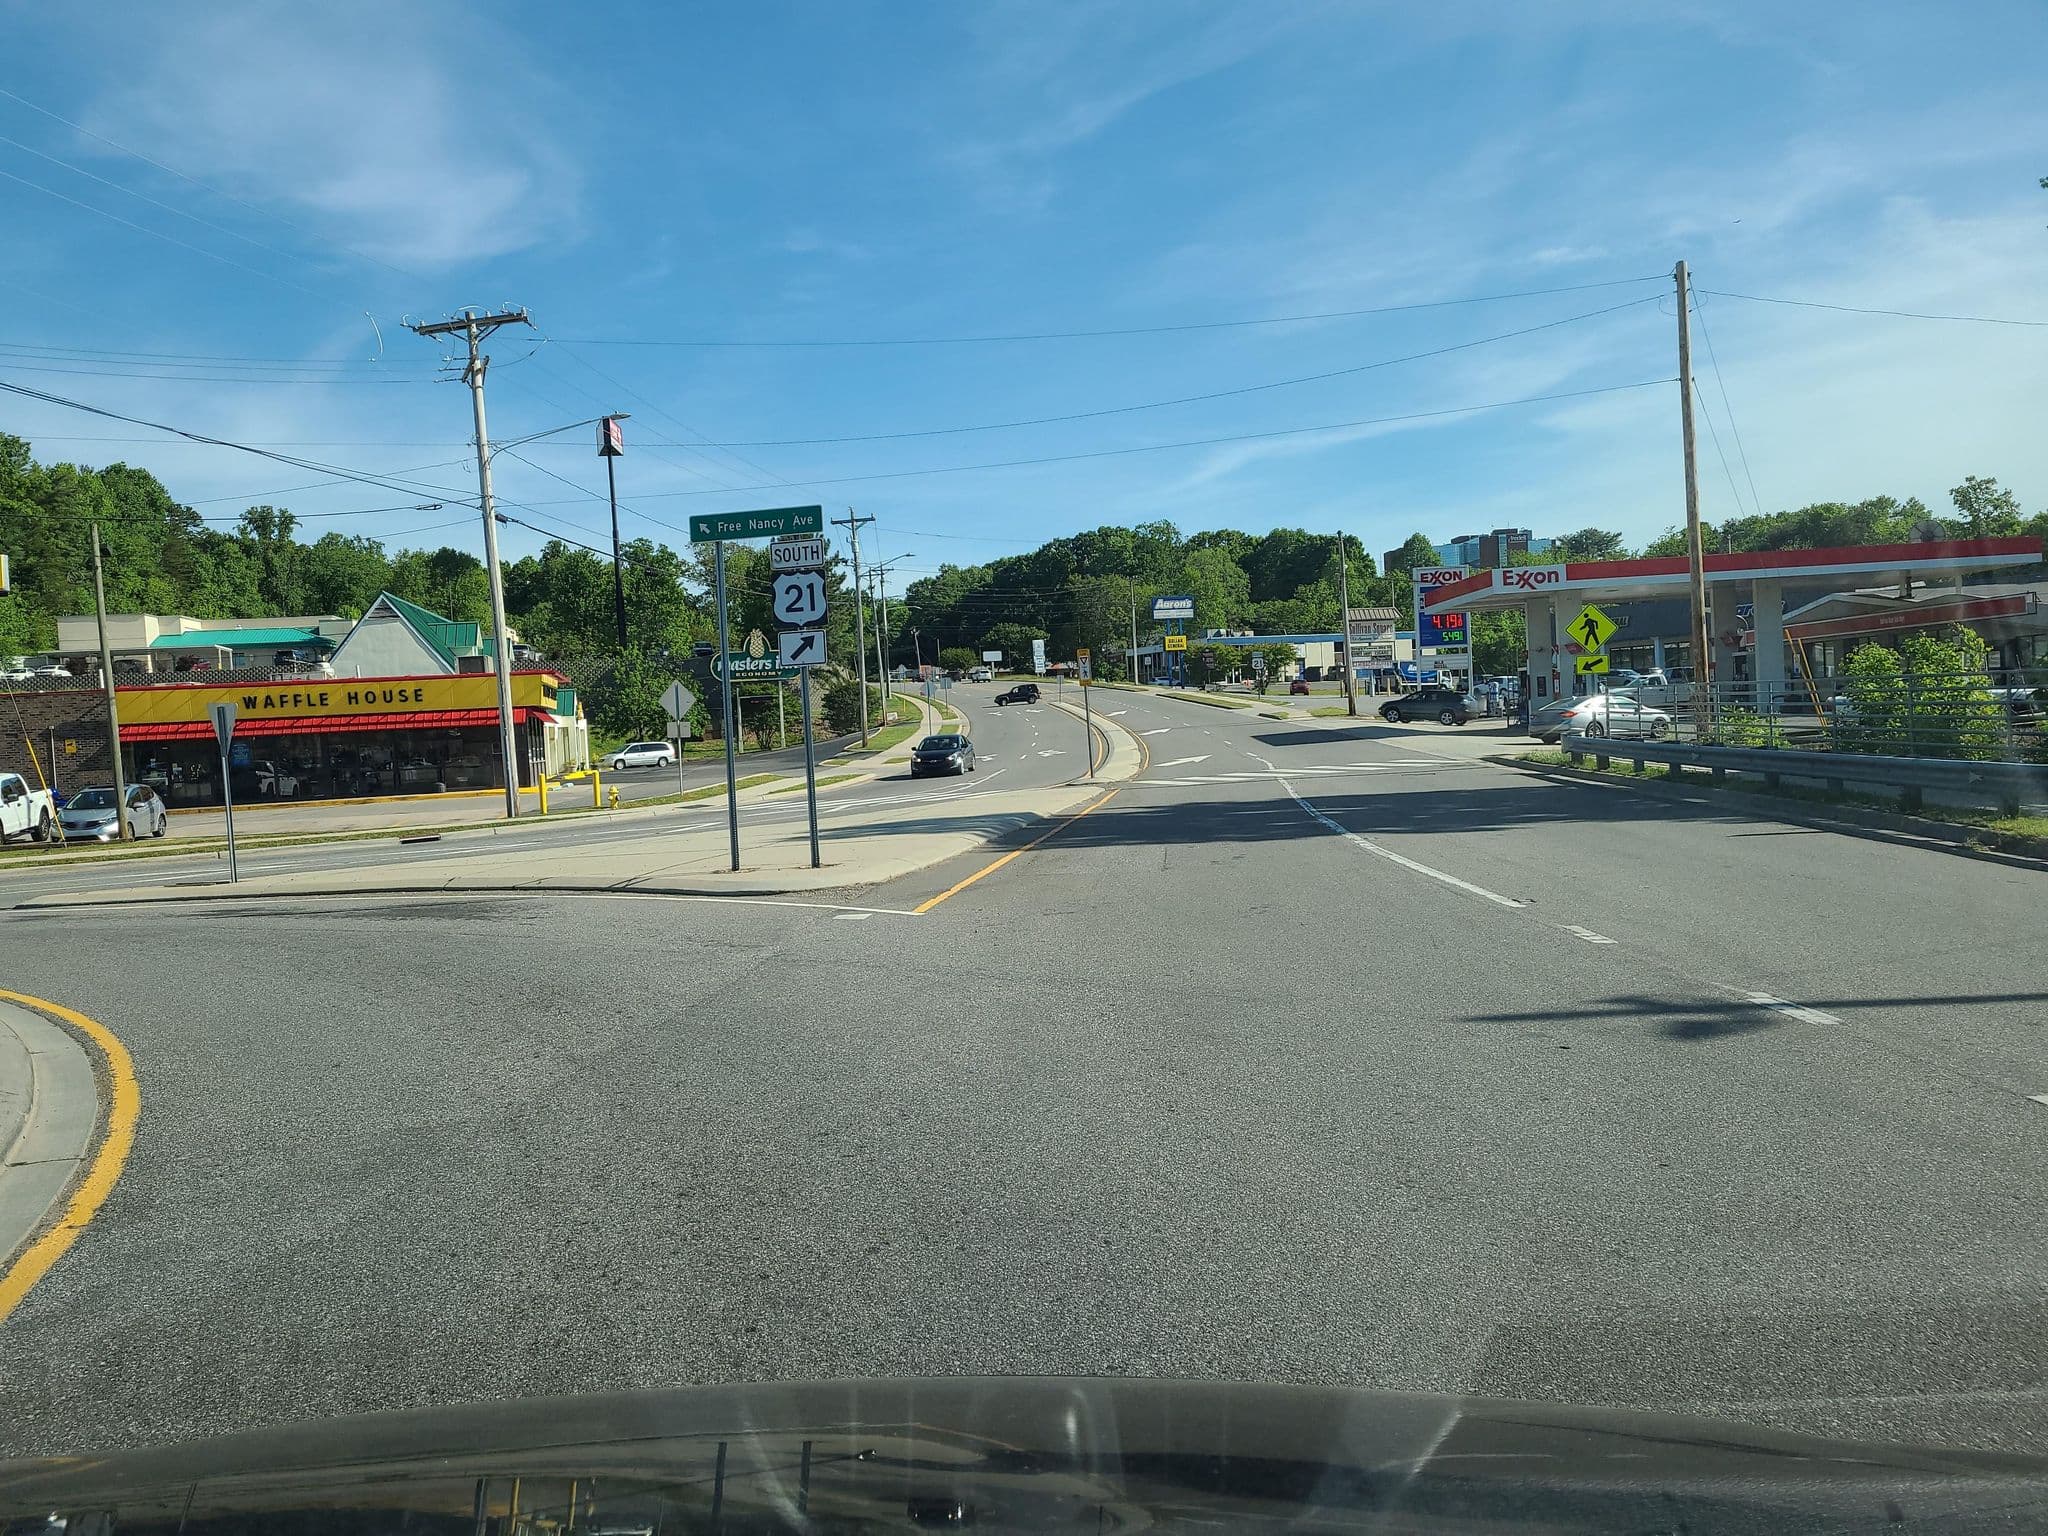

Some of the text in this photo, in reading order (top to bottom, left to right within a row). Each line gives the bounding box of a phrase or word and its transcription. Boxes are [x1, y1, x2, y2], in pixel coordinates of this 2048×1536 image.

[718, 515, 813, 533] Free Nancy Ave
[774, 545, 820, 564] SOUTH
[1420, 571, 1463, 585] EXXON
[1502, 570, 1560, 590] Exxon
[784, 582, 816, 613] 21
[1155, 598, 1193, 609] Aaron's
[1253, 659, 1263, 668] 21
[242, 688, 424, 710] WAFFLE HOUSE
